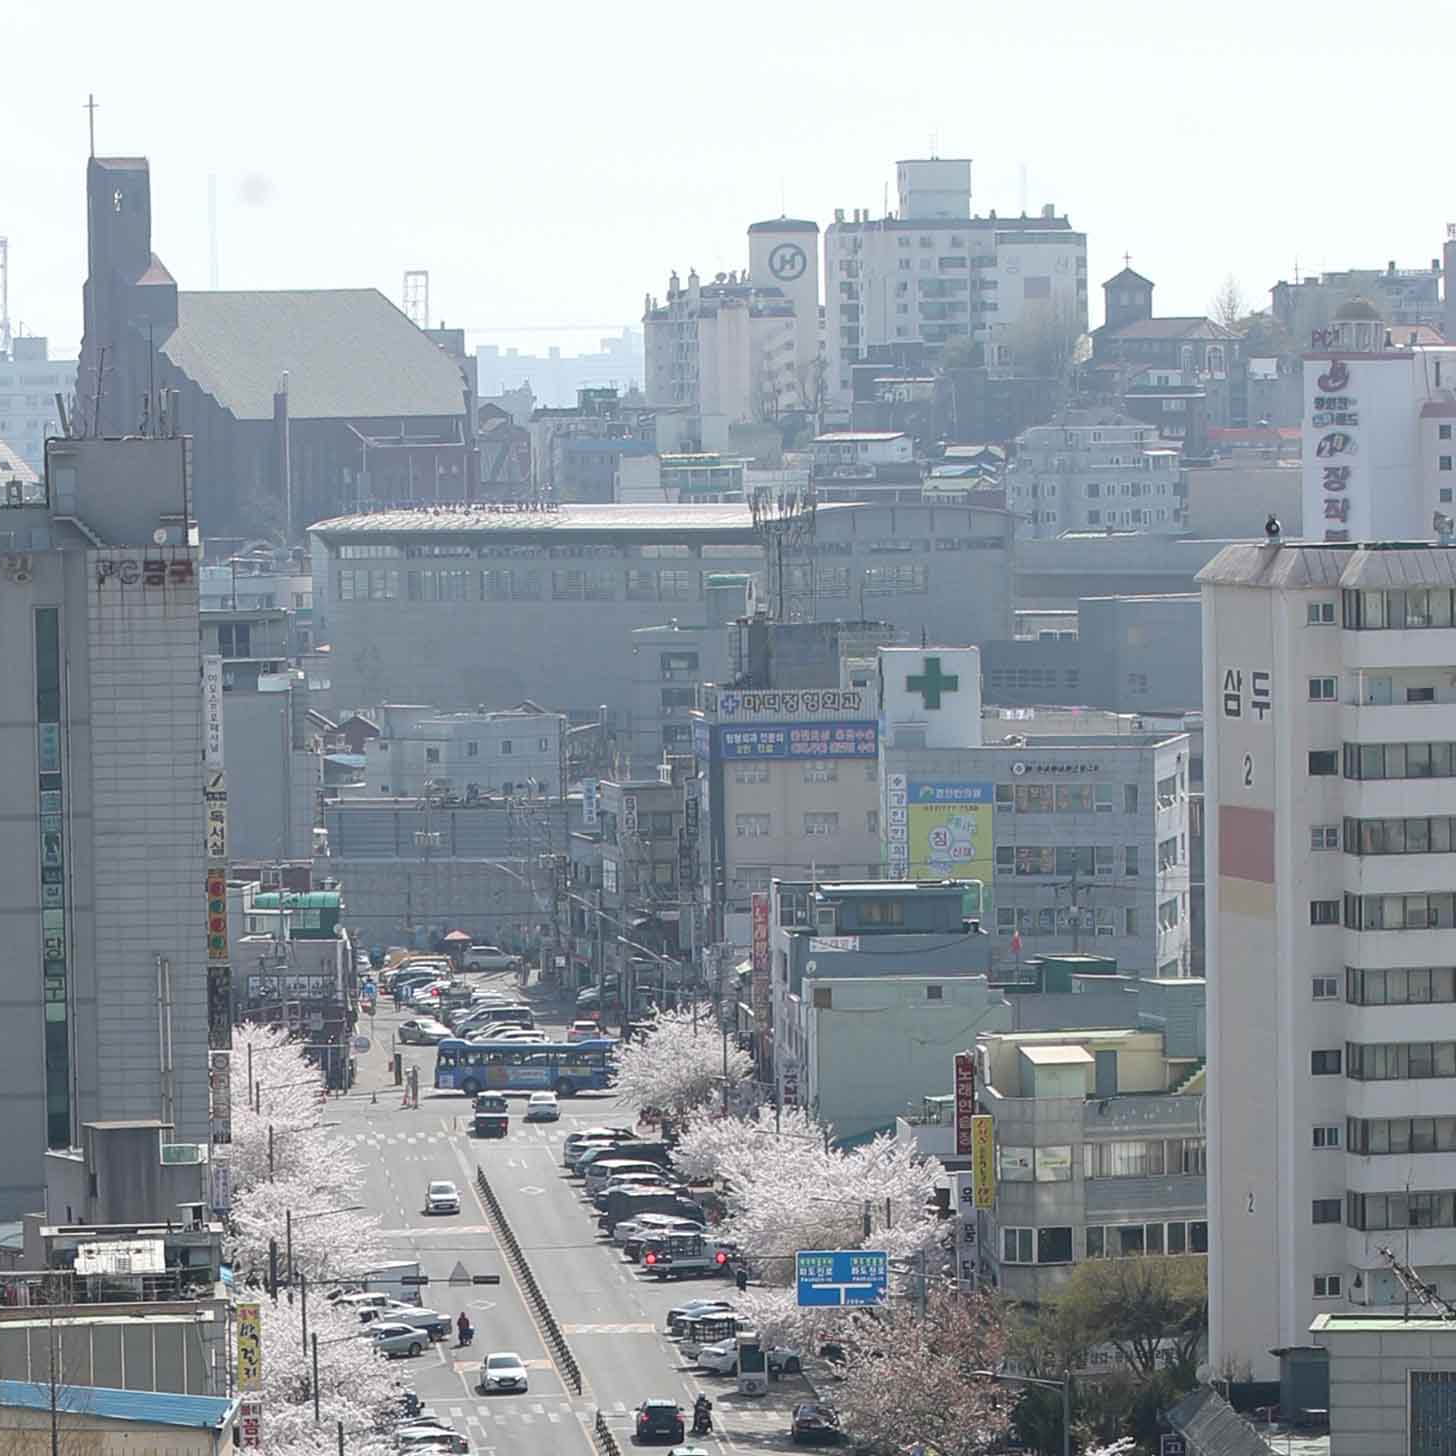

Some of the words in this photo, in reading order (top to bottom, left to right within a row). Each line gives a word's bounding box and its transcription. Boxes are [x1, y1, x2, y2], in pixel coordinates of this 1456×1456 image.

[1224, 669, 1271, 721] 삼두
[1243, 754, 1253, 786] 2
[210, 811, 224, 856] 독서실
